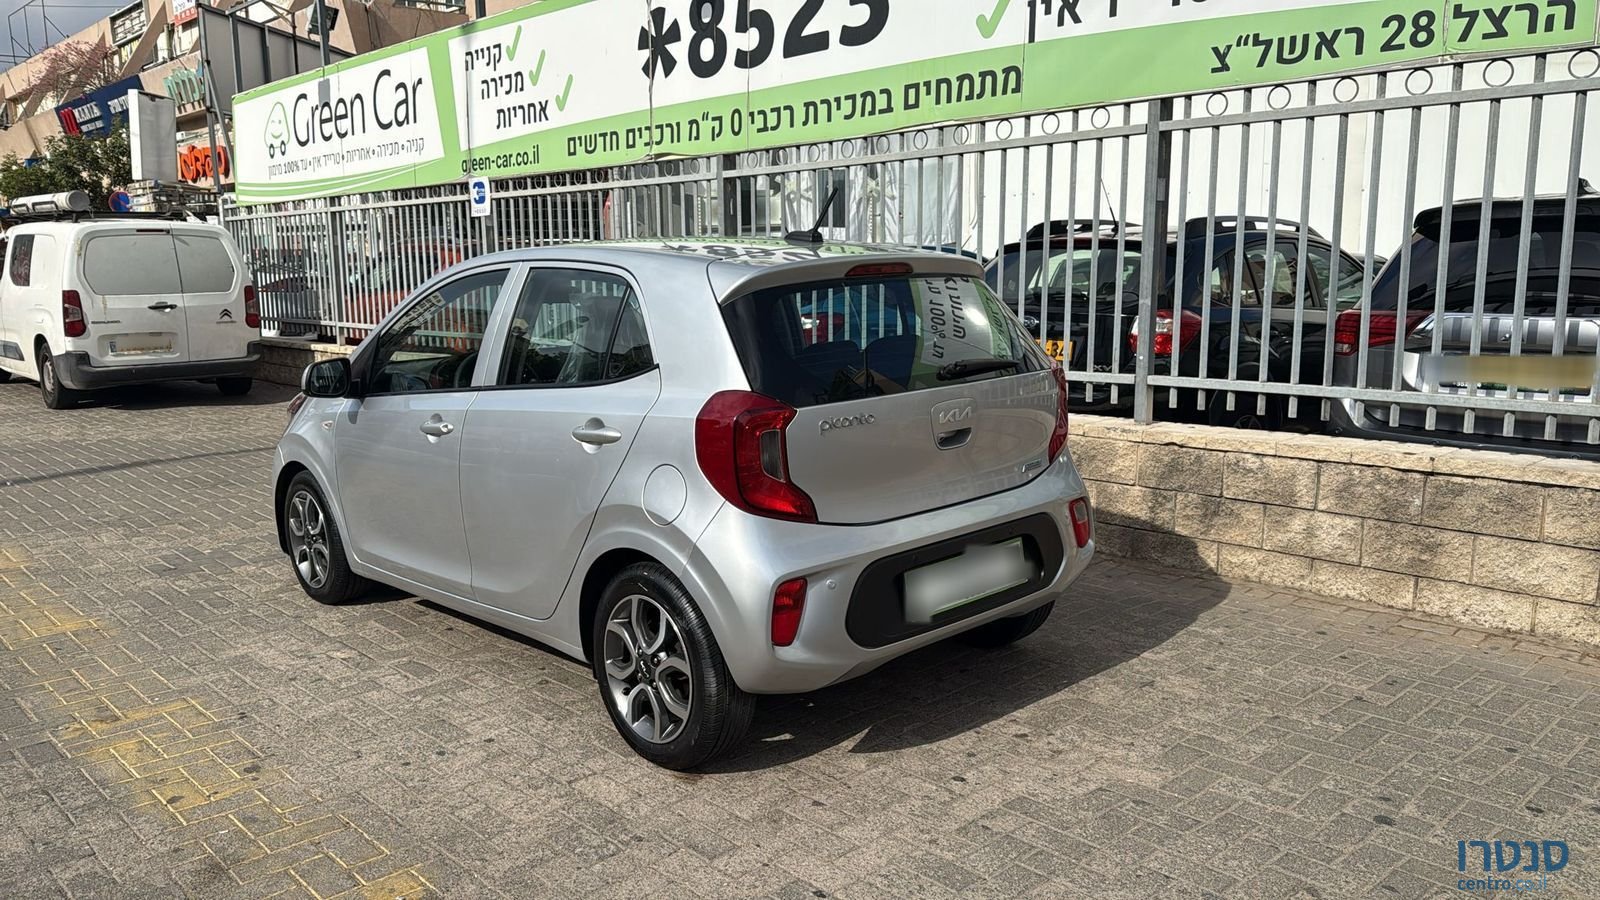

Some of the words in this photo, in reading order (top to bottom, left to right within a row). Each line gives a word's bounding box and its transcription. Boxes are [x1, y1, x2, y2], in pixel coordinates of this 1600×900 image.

[1380, 10, 1436, 53] 28
[1452, 0, 1577, 42] הרצל
[465, 43, 502, 71] קנייה
[1210, 26, 1365, 74] ראשל"צ
[481, 71, 525, 100] מכירה
[903, 65, 1022, 111] מתמחים
[293, 93, 366, 147] Green
[373, 69, 423, 130] Car
[496, 99, 549, 130] אחריות
[730, 107, 743, 136] 0
[748, 104, 795, 134] רכבי
[802, 87, 894, 127] במכירת
[377, 141, 400, 158] מכירה
[406, 137, 425, 156] קניה
[567, 130, 620, 157] חדשים
[625, 121, 681, 149] ורכבים
[284, 160, 300, 174] 100%
[818, 413, 876, 438] picanto
